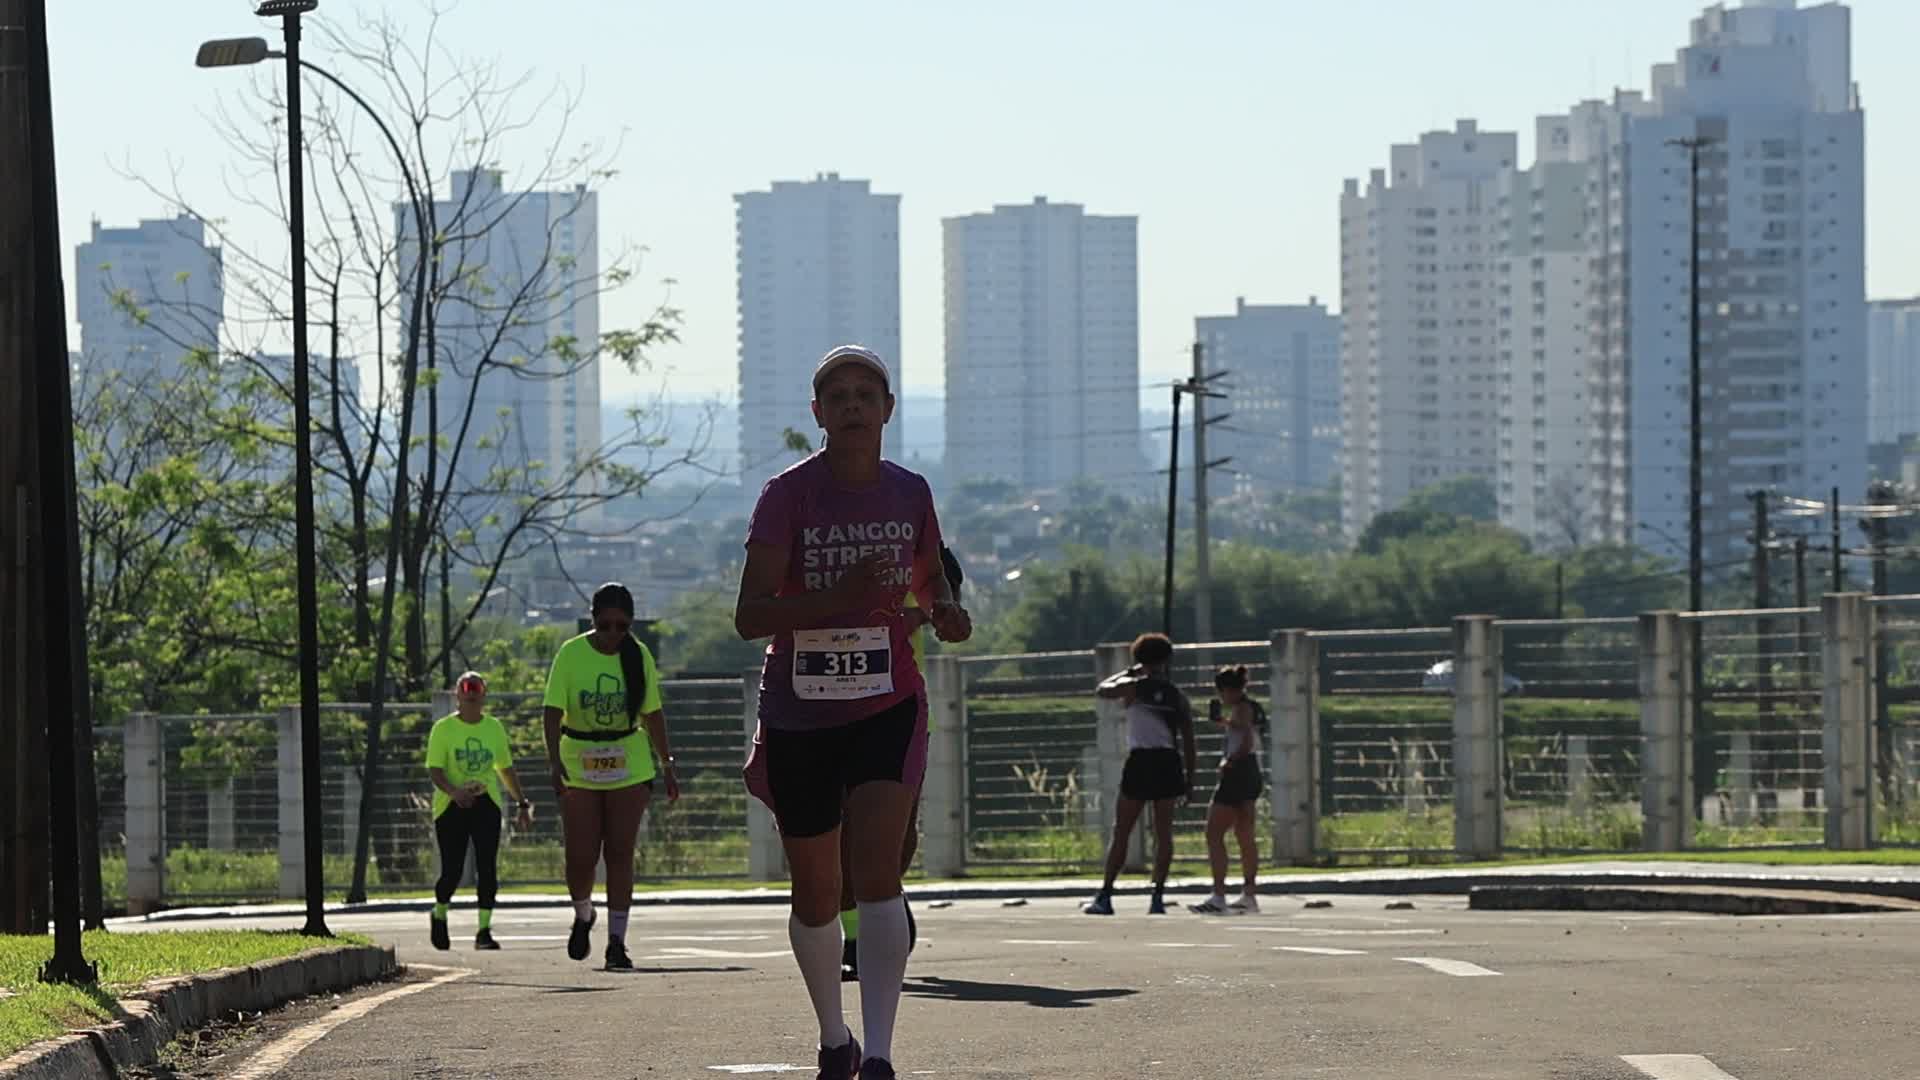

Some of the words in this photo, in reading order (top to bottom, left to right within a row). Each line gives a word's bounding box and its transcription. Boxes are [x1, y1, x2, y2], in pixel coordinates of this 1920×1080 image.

[803, 521, 914, 545] KANGOO
[804, 567, 913, 591] RUNG
[823, 652, 868, 675] 313
[592, 756, 617, 769] 792
